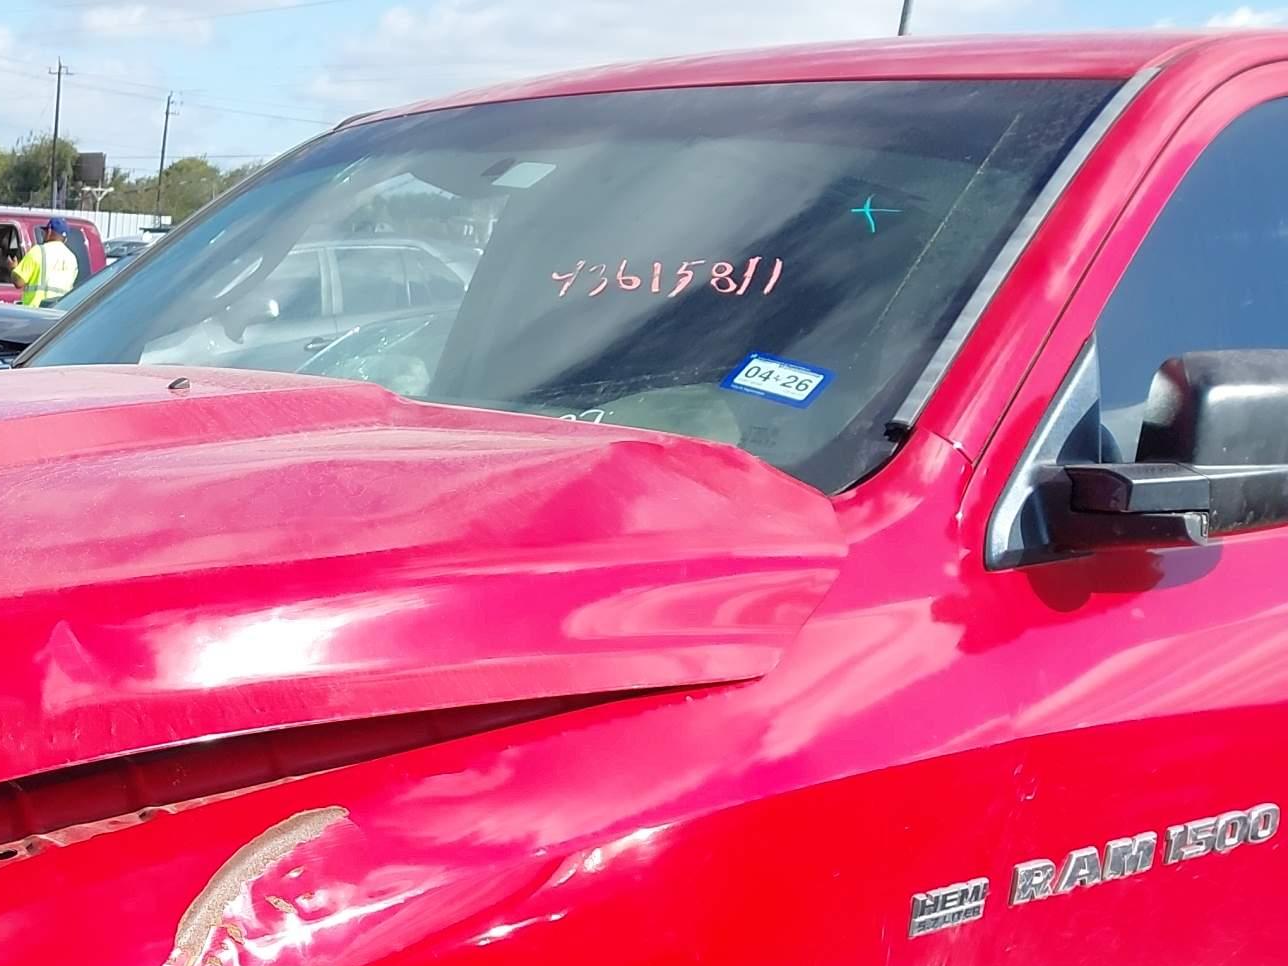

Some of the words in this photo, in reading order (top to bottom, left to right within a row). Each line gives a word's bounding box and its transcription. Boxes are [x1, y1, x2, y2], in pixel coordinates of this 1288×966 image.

[551, 256, 783, 298] 43615811
[1009, 831, 1158, 906] RAM
[1163, 802, 1281, 864] 1500
